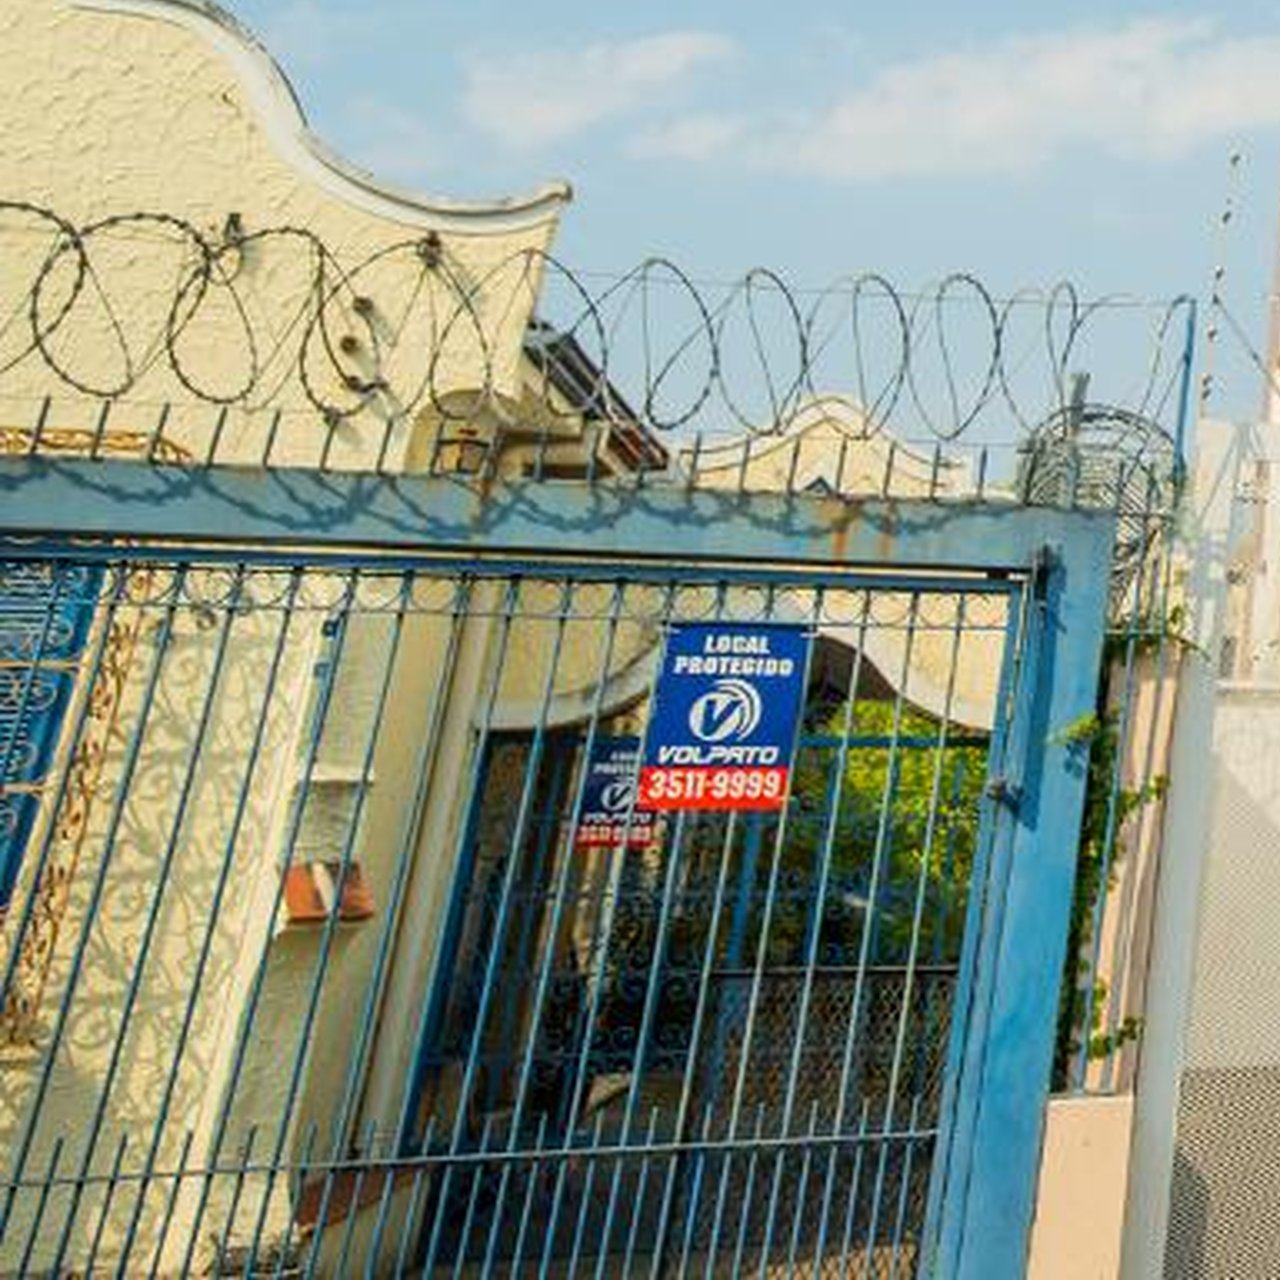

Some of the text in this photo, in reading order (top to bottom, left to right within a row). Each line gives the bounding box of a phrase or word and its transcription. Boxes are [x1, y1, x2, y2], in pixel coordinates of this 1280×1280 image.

[703, 634, 771, 655] LOCAL
[673, 655, 795, 676] PROTECIDO
[657, 745, 780, 765] VOLPATO
[648, 770, 781, 800] 3511-9999
